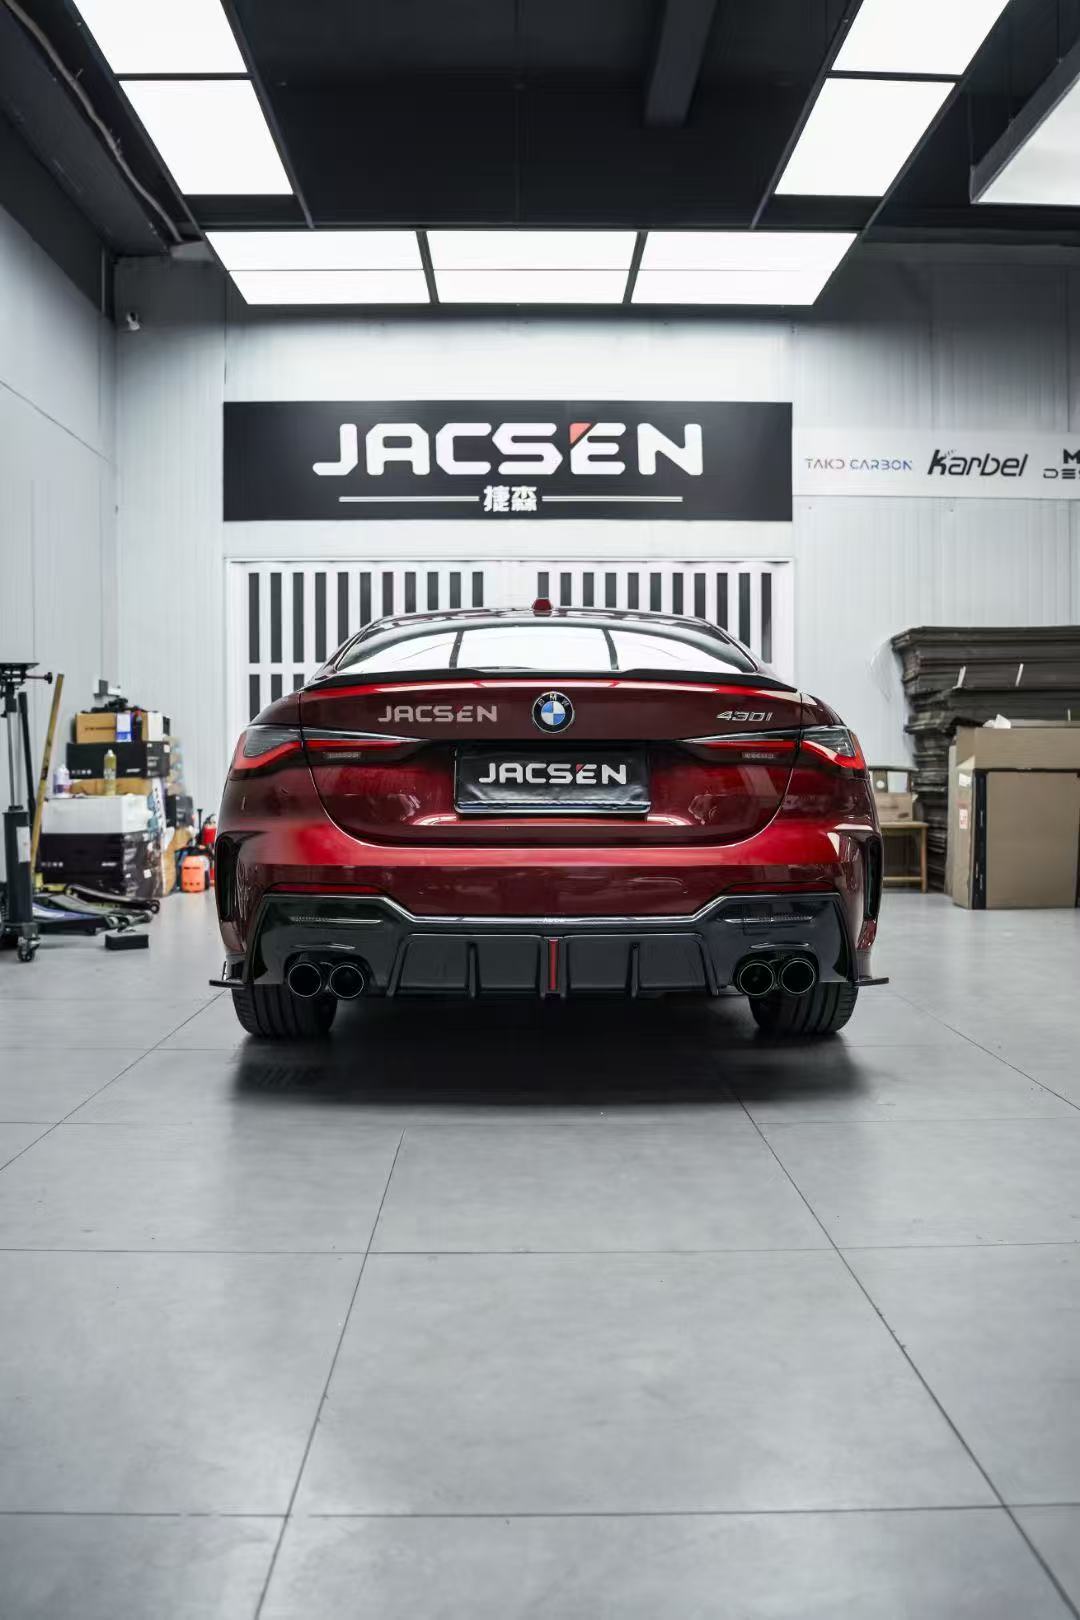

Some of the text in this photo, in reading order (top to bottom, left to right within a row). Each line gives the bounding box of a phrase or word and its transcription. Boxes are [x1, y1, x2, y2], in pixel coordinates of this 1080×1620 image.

[312, 422, 703, 476] JACSEN
[849, 458, 912, 471] CARBON
[1043, 468, 1080, 480] DE
[483, 485, 537, 512] 捷森
[378, 705, 498, 723] JACSEN
[479, 762, 627, 785] JACSEN
